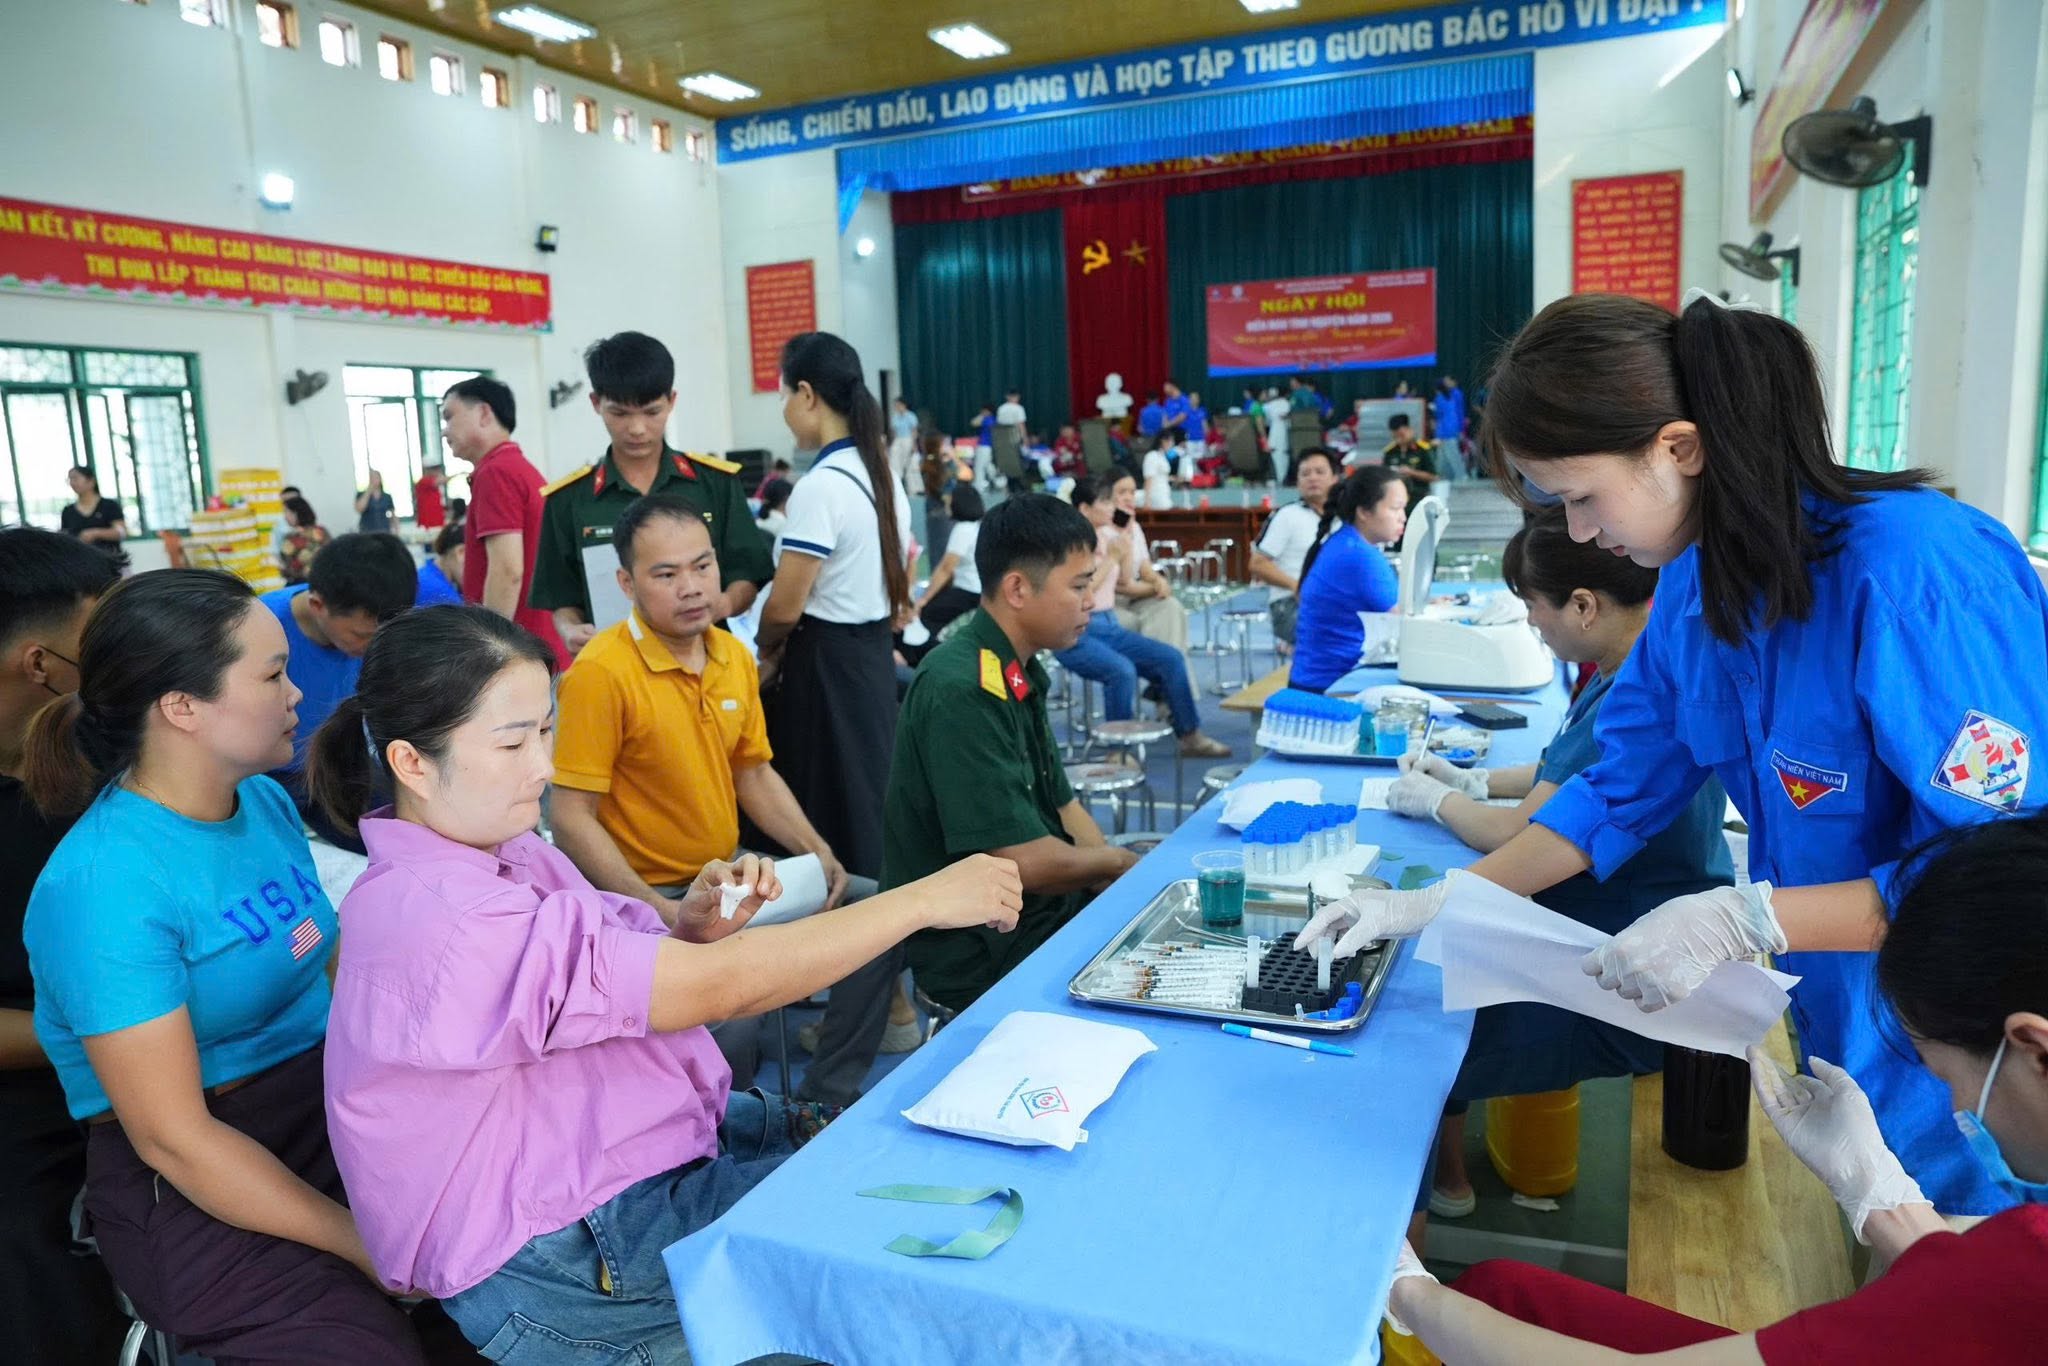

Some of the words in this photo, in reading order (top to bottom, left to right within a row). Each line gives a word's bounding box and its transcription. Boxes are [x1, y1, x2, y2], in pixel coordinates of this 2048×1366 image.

[731, 115, 798, 152] SỐNG,
[803, 100, 872, 140] CHIẾN
[878, 90, 935, 129] ĐẤU,
[941, 86, 989, 119] LAO
[994, 74, 1067, 113] ĐỘNG
[1073, 64, 1109, 98] VÀ
[1115, 59, 1172, 95] HỌC
[1179, 47, 1234, 86] TẬP
[1242, 36, 1317, 74] THEO
[1325, 21, 1433, 63] GƯƠNG
[1442, 6, 1509, 48] BÁC
[1325, 291, 1367, 311] HỘI
[1787, 763, 1804, 776] NIÊN
[1822, 775, 1842, 786] NAM
[223, 865, 321, 944] USA
